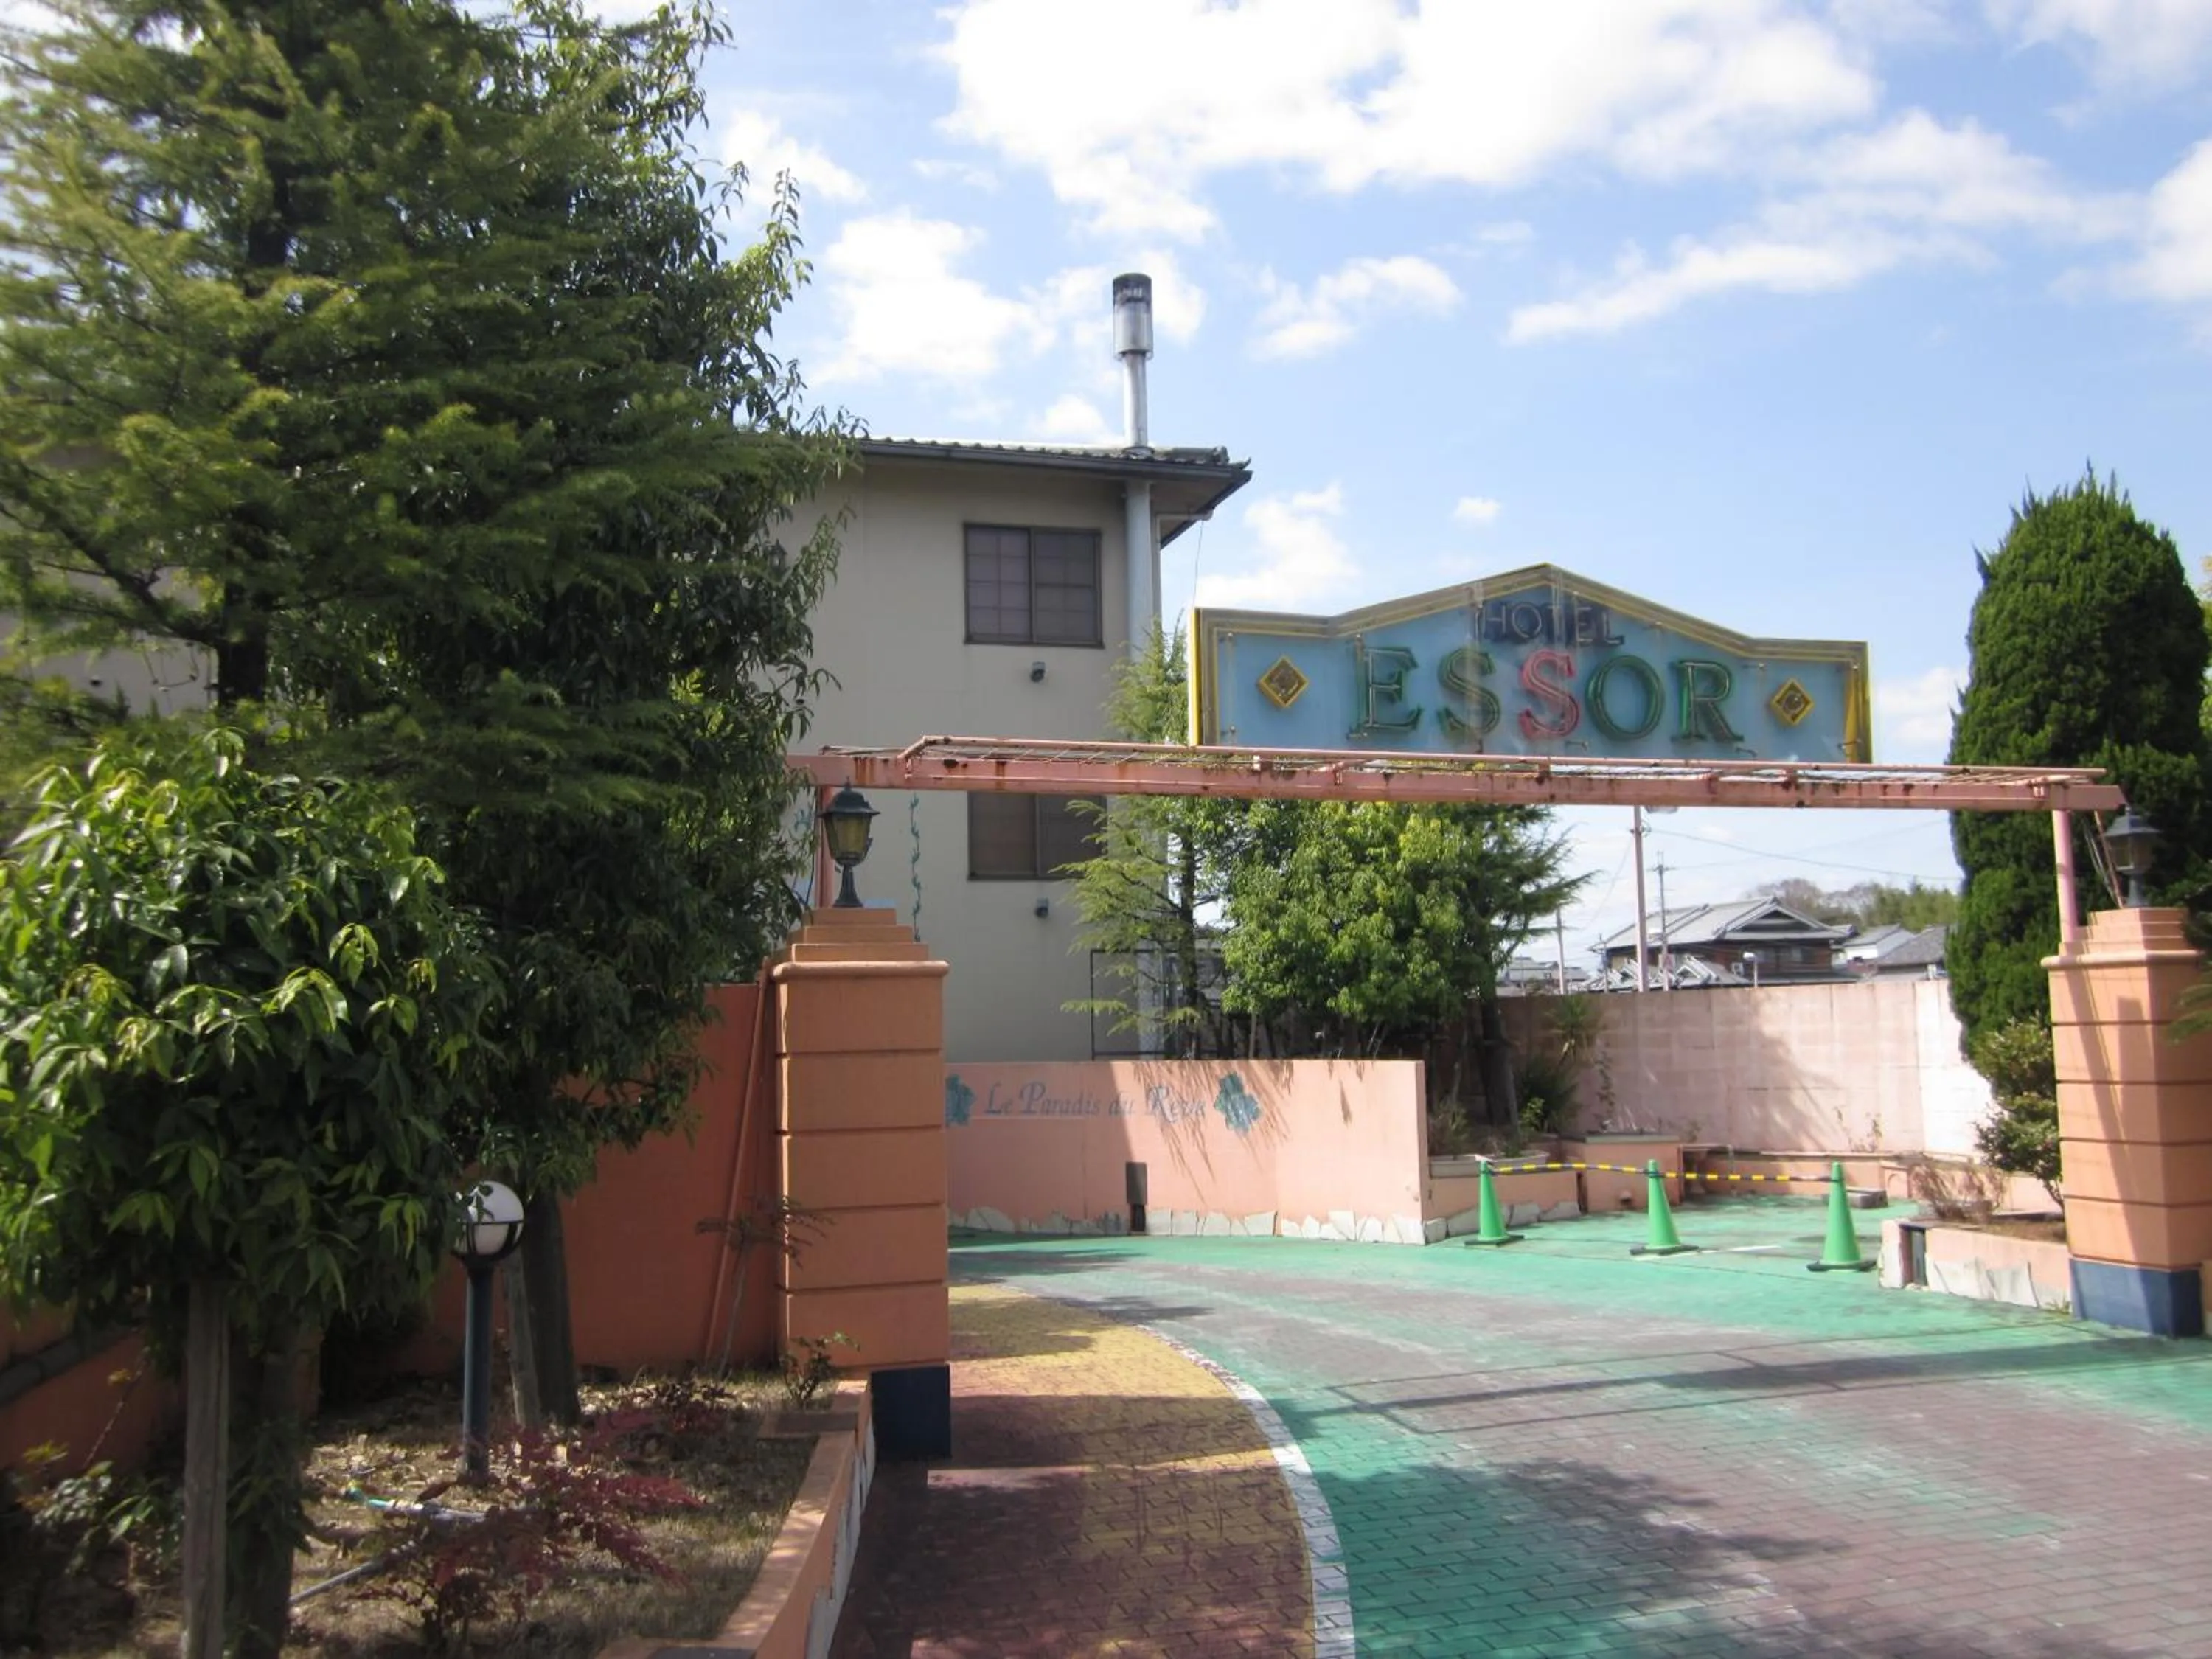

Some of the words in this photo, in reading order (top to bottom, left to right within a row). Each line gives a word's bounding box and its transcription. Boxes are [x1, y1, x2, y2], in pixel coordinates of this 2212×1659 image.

[1478, 600, 1624, 643] HOTEL
[1351, 648, 1743, 742] ESSOR
[984, 1082, 1013, 1116] Le
[1019, 1082, 1101, 1116] Paradis
